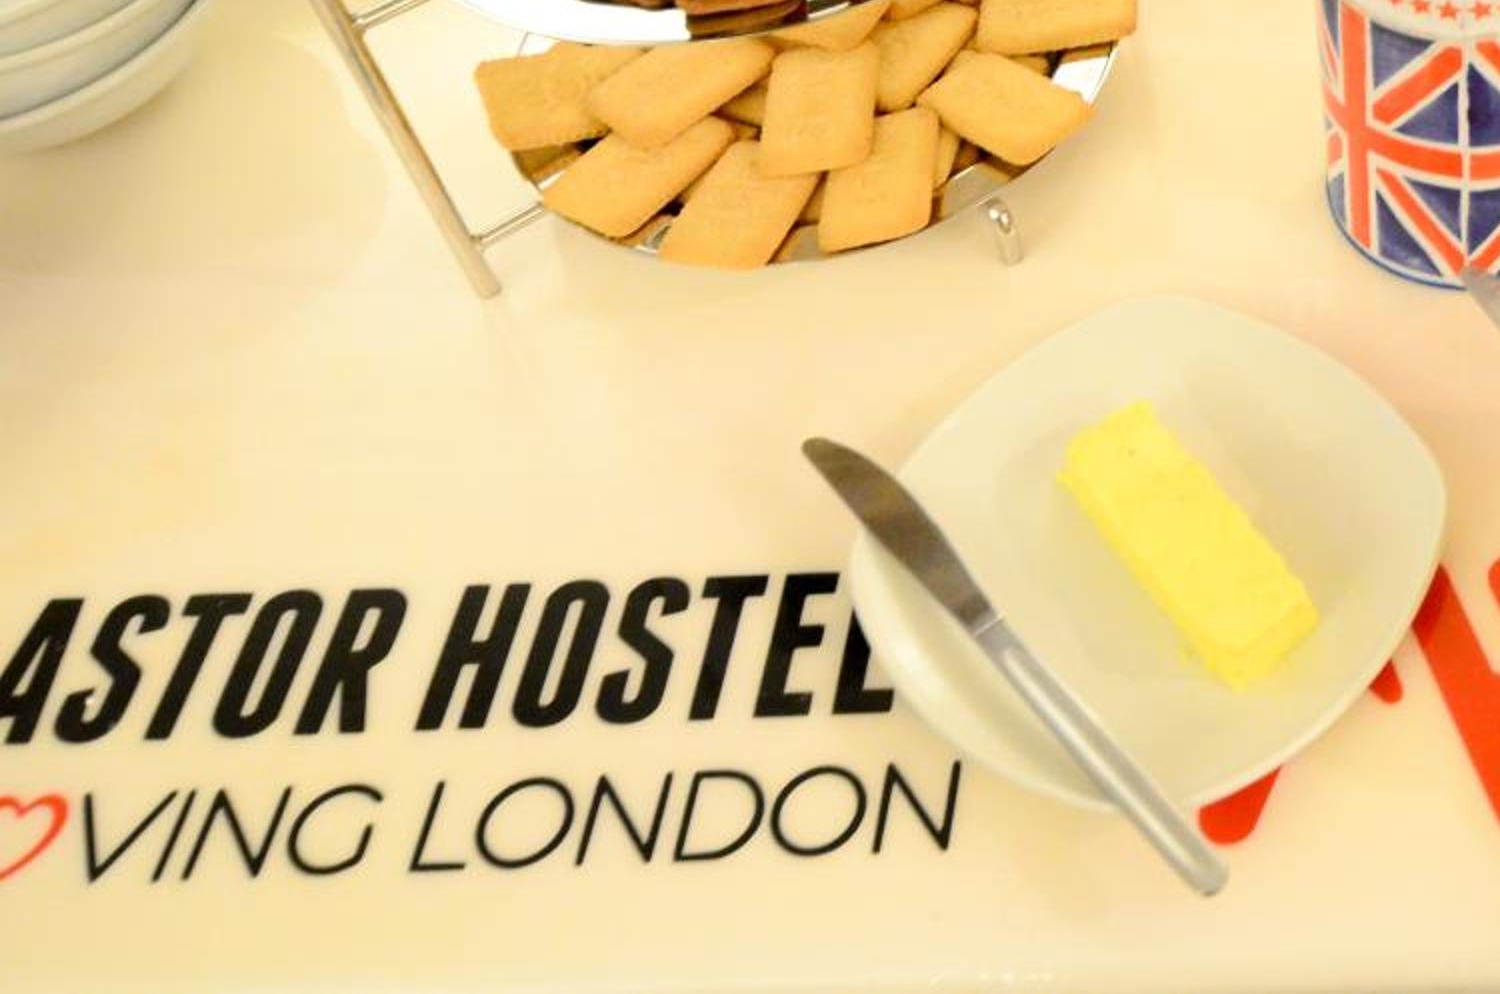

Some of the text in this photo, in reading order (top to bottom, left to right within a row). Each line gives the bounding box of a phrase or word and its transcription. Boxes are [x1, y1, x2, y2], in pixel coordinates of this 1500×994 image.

[0, 571, 896, 745] ASTOR HOSTEL
[409, 760, 962, 873] LONDON
